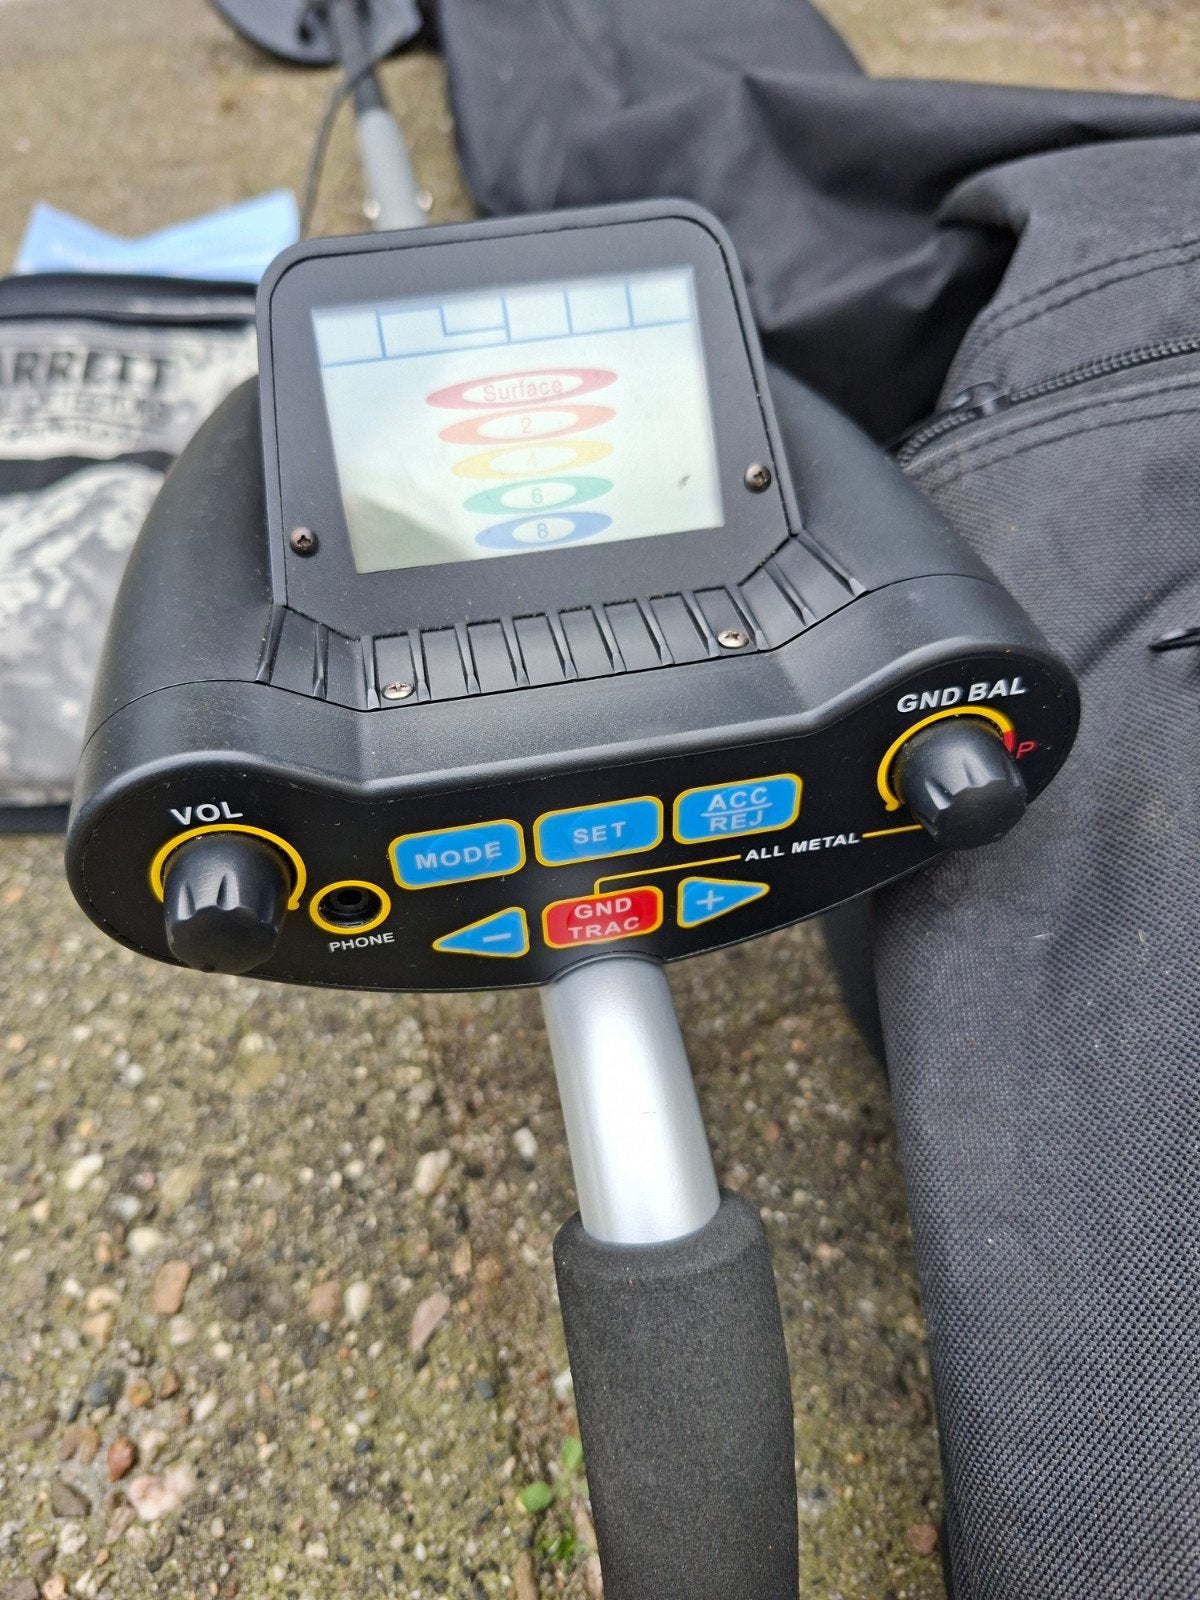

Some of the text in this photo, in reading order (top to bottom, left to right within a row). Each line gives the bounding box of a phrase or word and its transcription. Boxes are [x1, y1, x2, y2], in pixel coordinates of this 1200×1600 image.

[483, 378, 564, 402] Surface
[520, 417, 533, 434] 2
[531, 488, 543, 505] 6
[537, 523, 549, 540] 8
[896, 677, 1027, 713] GND BAL
[1015, 741, 1036, 760] P
[707, 786, 768, 812] ACC
[170, 801, 243, 827] VOL
[709, 811, 764, 832] REJ
[572, 821, 626, 845] SET
[414, 841, 503, 870] MODE
[744, 832, 860, 862] ALL METAL
[573, 897, 632, 919] GND
[567, 917, 640, 941] TRAC
[328, 931, 396, 953] PHONE
